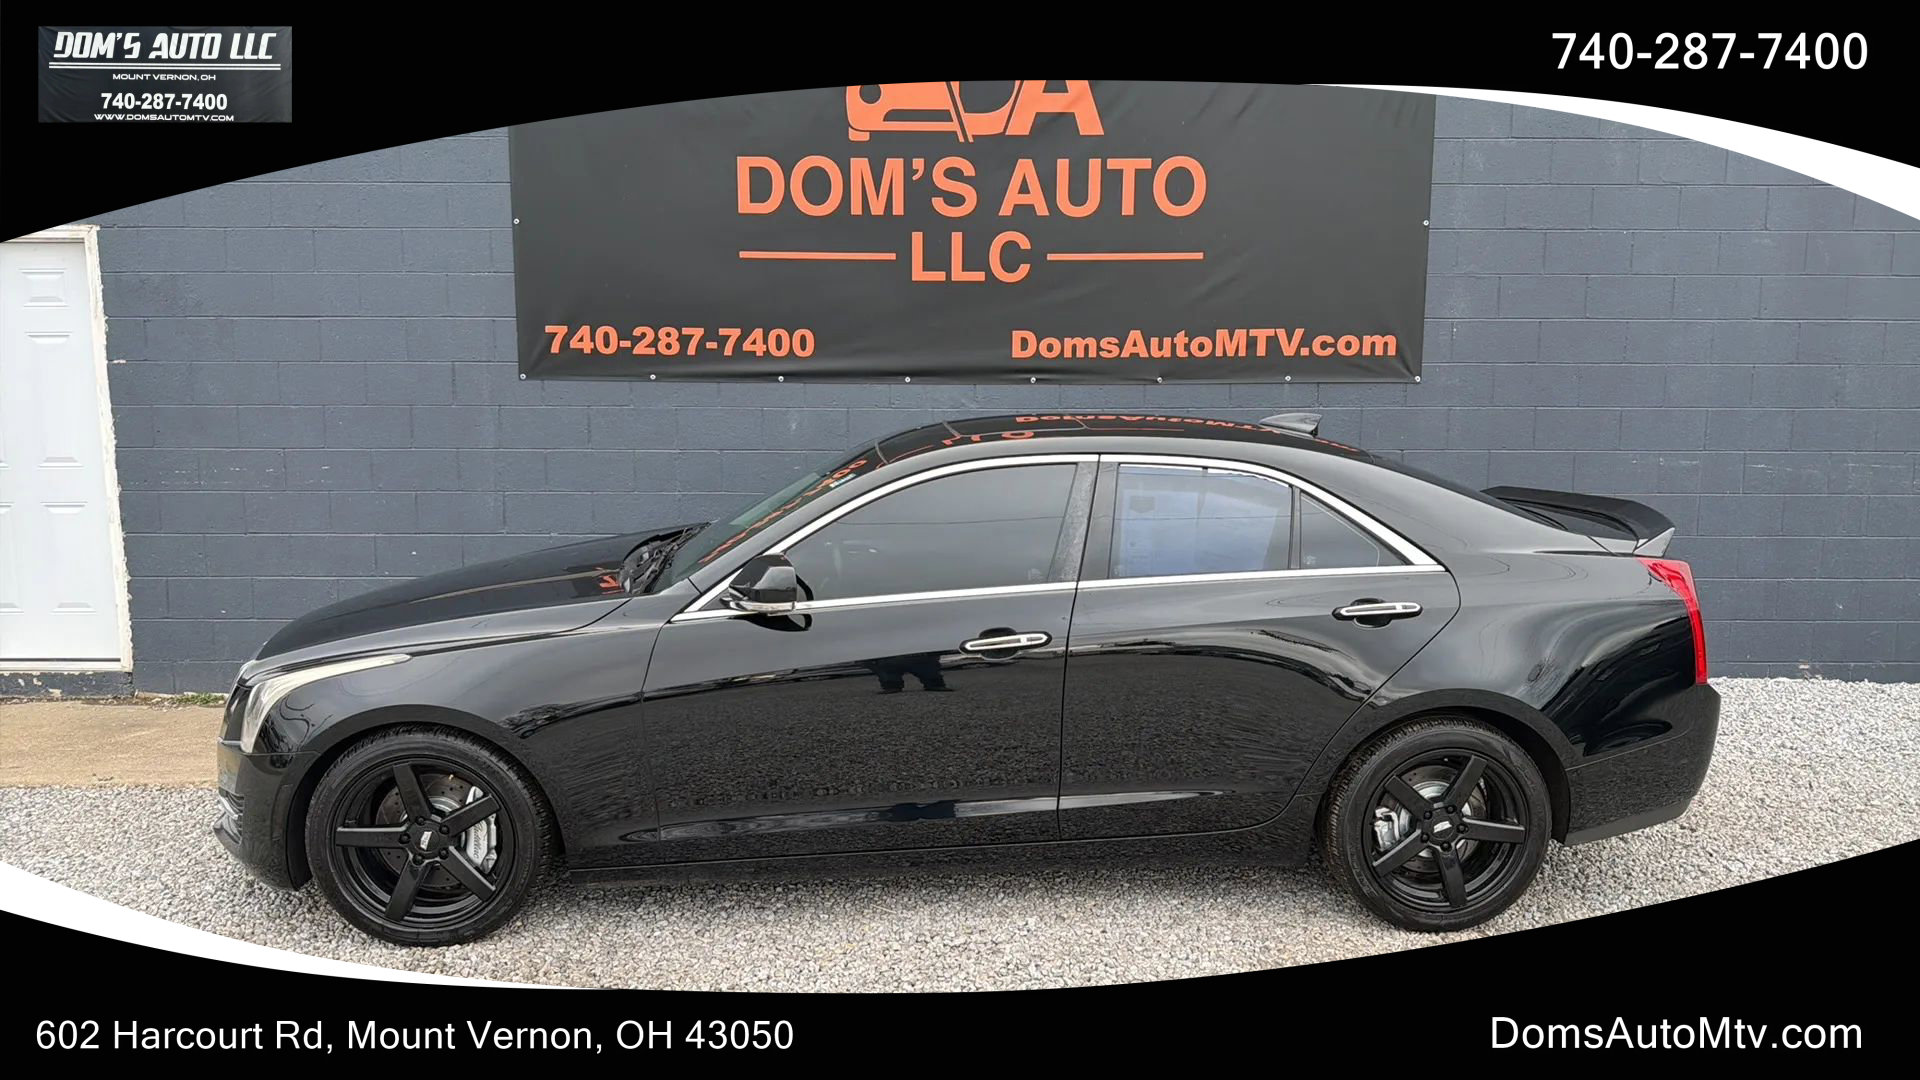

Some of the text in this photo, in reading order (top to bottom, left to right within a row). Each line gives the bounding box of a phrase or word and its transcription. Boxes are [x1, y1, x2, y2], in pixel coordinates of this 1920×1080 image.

[736, 155, 1208, 219] DOM'S AUTO
[911, 231, 1034, 284] LLC
[545, 325, 1398, 361] 740-287-7400 DomsAutoMTV.com
